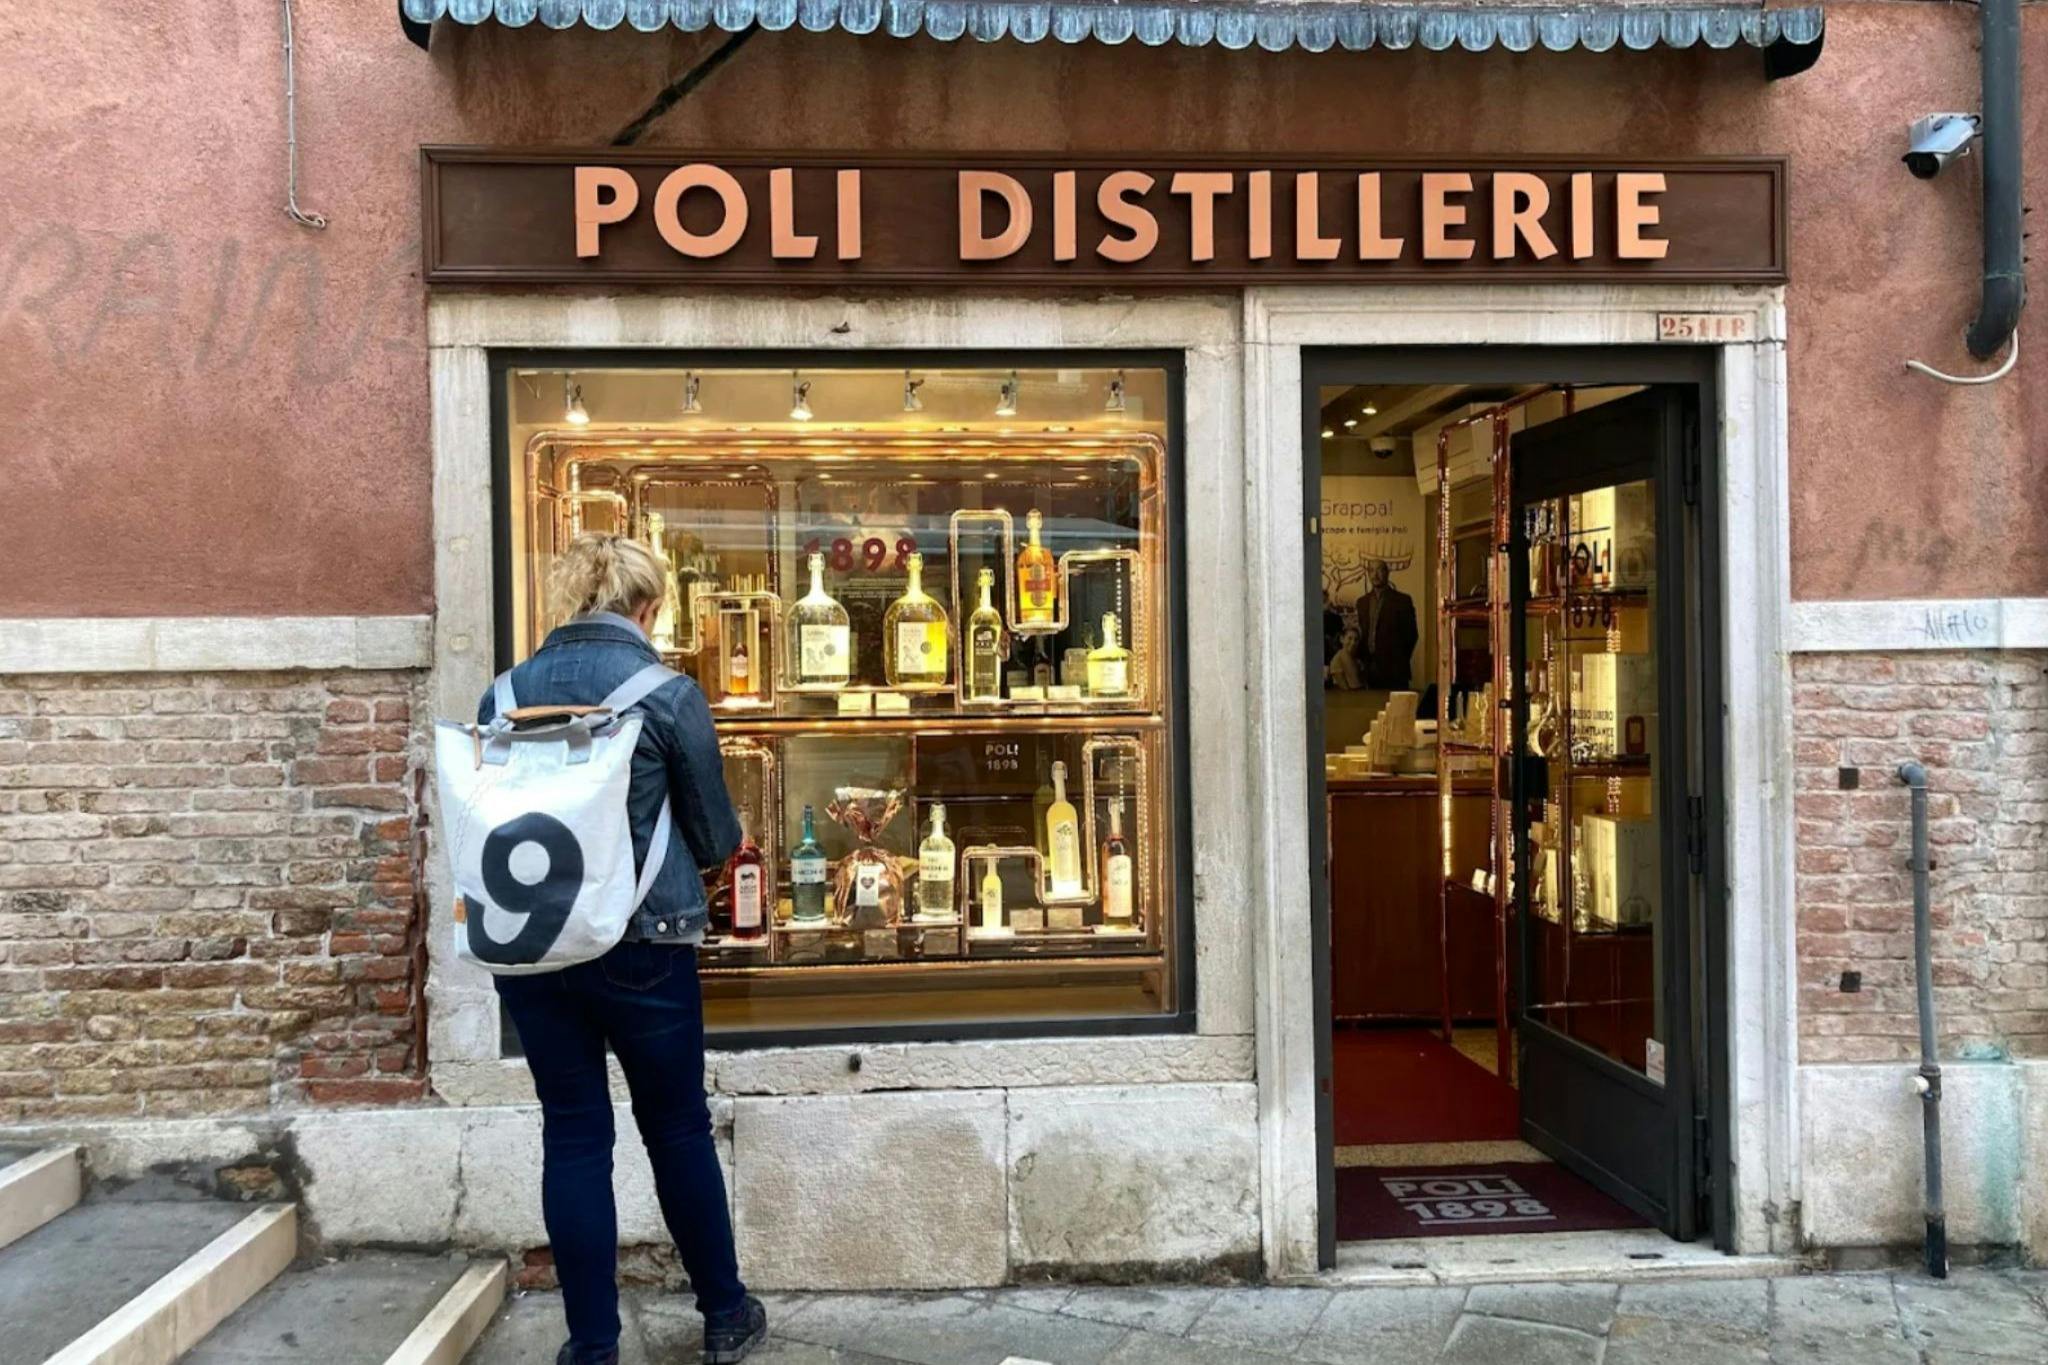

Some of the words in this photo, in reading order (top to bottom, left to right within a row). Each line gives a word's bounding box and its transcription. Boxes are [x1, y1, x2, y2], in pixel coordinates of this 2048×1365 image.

[574, 163, 863, 261] POLI
[958, 170, 1670, 263] DISTILLERIE
[464, 811, 585, 965] 9
[1384, 1178, 1524, 1198] POLI
[1403, 1198, 1550, 1220] 1898
